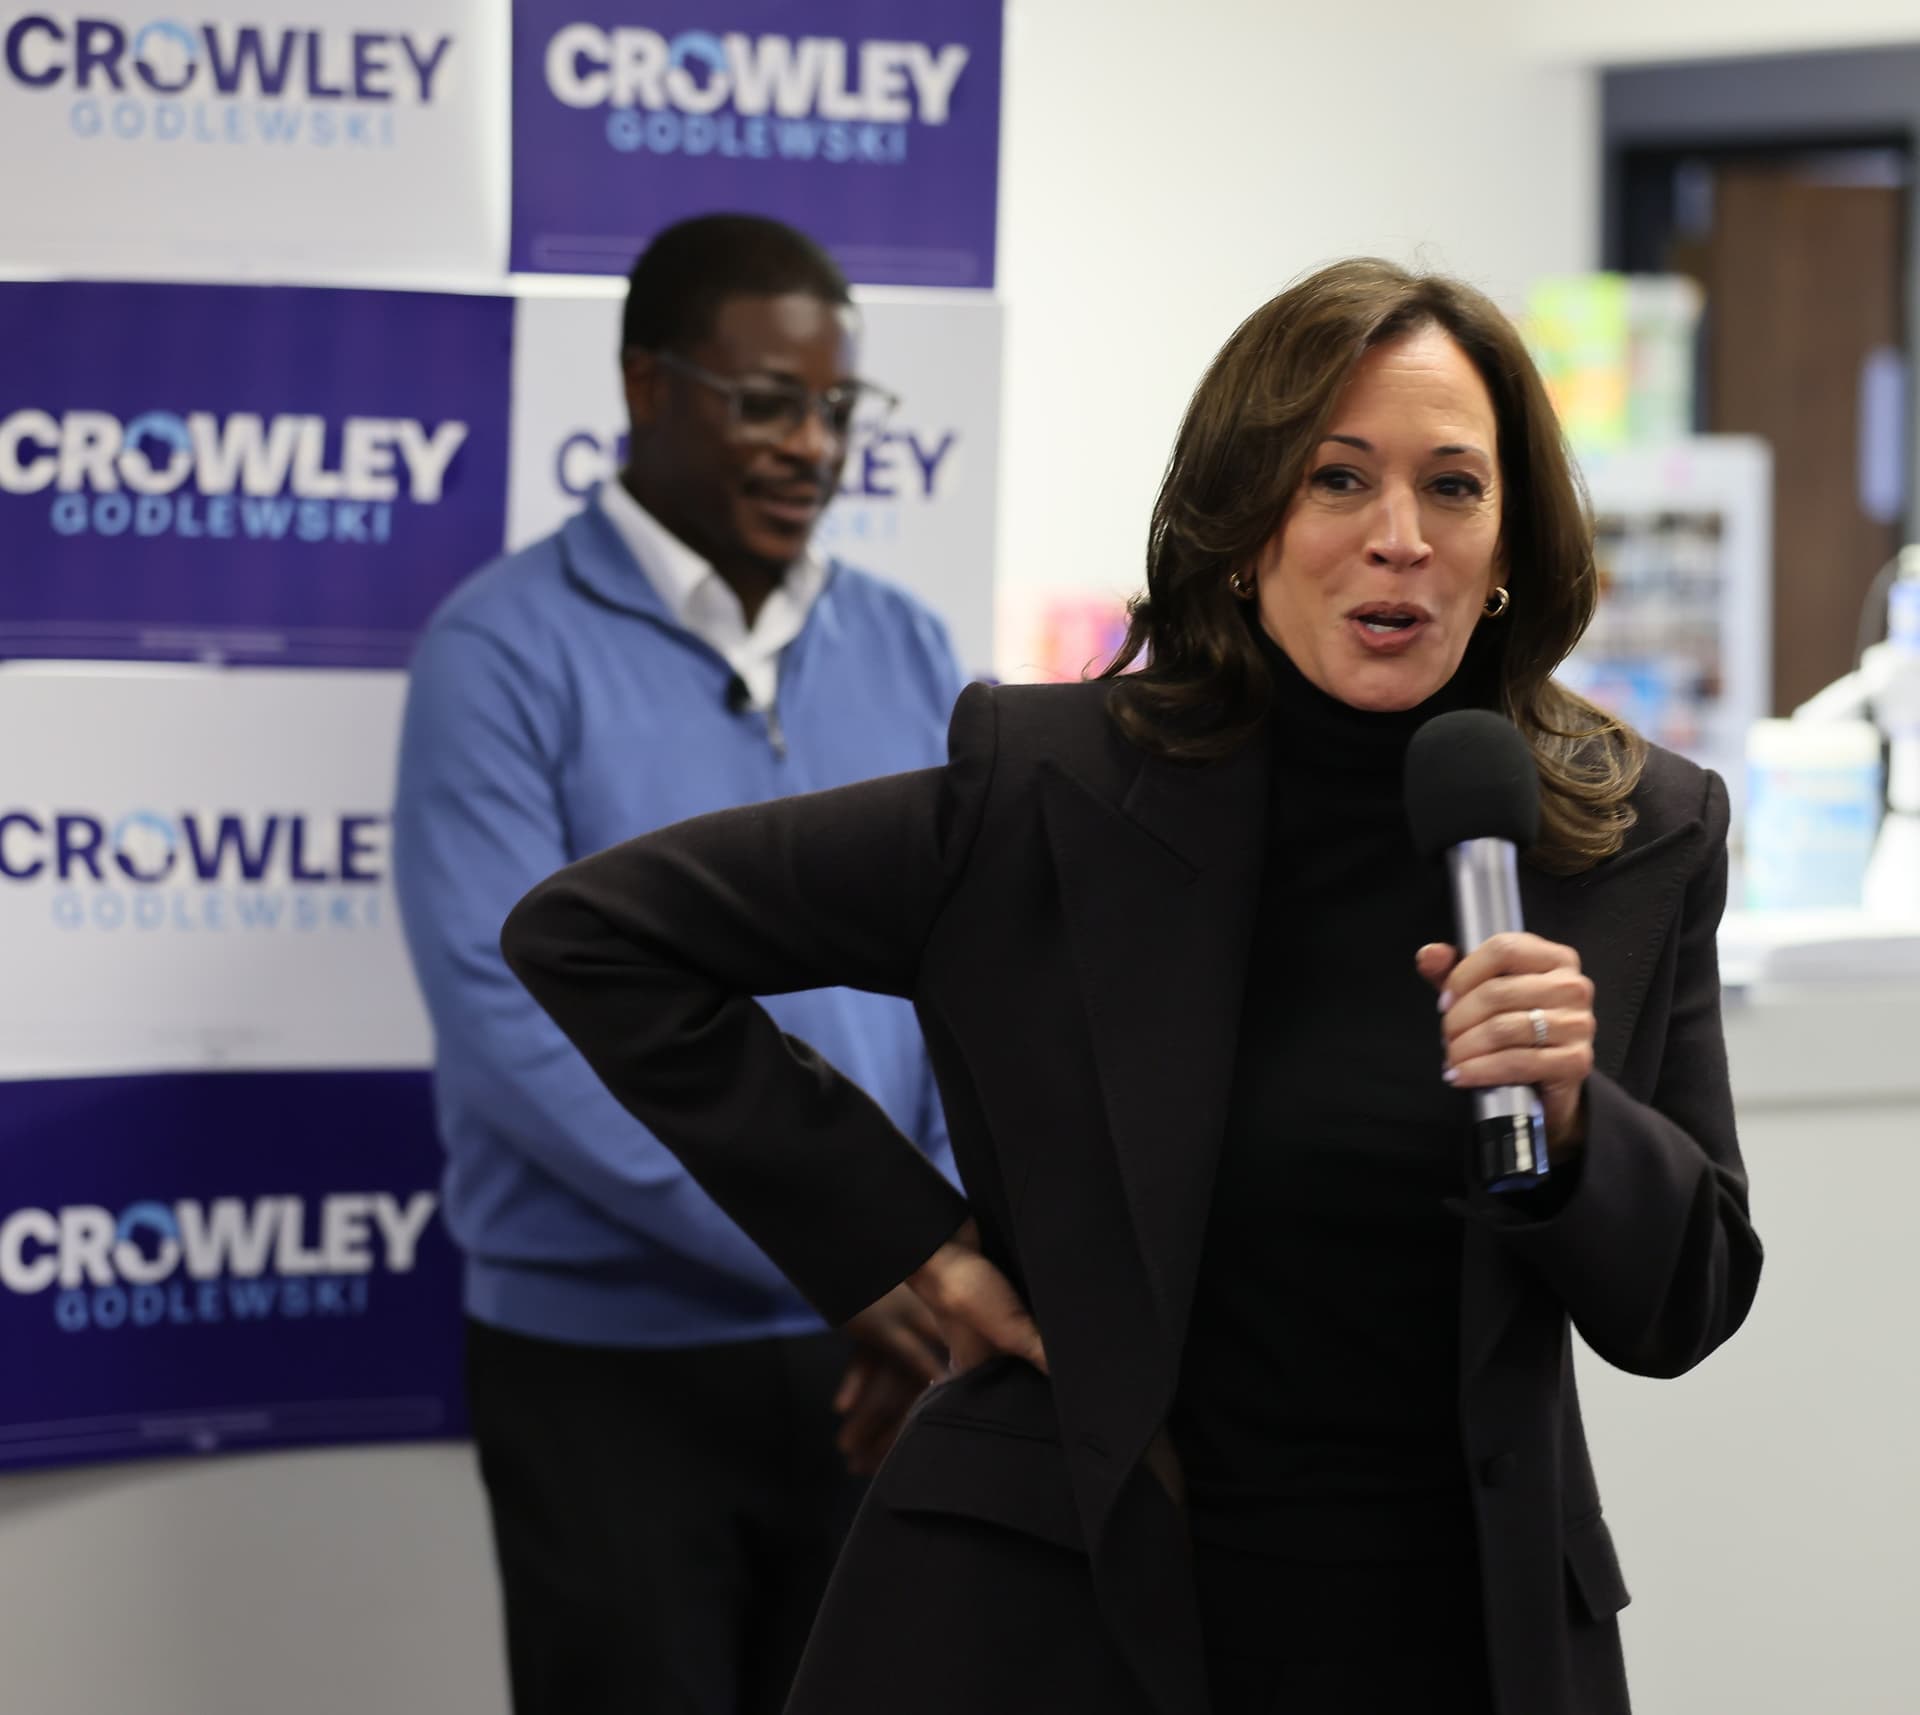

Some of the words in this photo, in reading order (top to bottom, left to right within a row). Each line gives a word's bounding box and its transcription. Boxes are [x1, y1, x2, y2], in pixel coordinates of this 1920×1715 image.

[5, 15, 452, 105] CROWLEY
[545, 22, 970, 125] CROWLEY
[70, 101, 396, 147] GODLEWSKI
[606, 109, 907, 163] GODLEWSKI
[0, 409, 468, 503] CROWLEY
[50, 494, 392, 543] GODLEWSKI
[0, 812, 395, 884] CROWLE
[51, 891, 384, 931] GODLEWSKI
[0, 1192, 438, 1293] CROWLEY
[54, 1277, 369, 1332] GODLEWSKI
